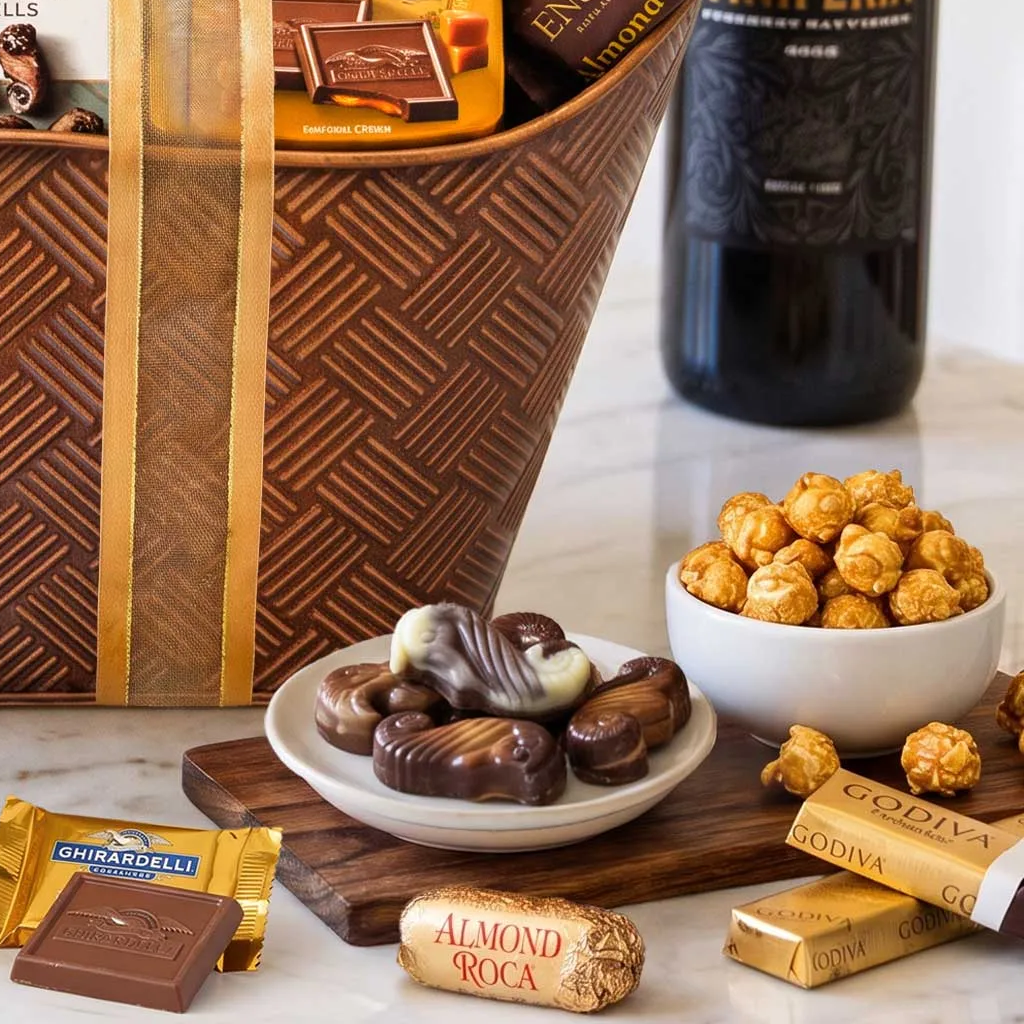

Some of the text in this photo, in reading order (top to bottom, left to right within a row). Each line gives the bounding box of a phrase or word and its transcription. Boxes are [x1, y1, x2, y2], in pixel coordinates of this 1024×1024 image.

[843, 783, 990, 849] GODIVA
[58, 846, 192, 873] GHIRARDELLI
[792, 824, 884, 874] GODIVA
[942, 884, 976, 915] GO
[434, 912, 562, 959] ALMOND
[756, 906, 853, 932] GODIVA
[898, 909, 961, 941] GODIV
[453, 951, 538, 991] ROCA
